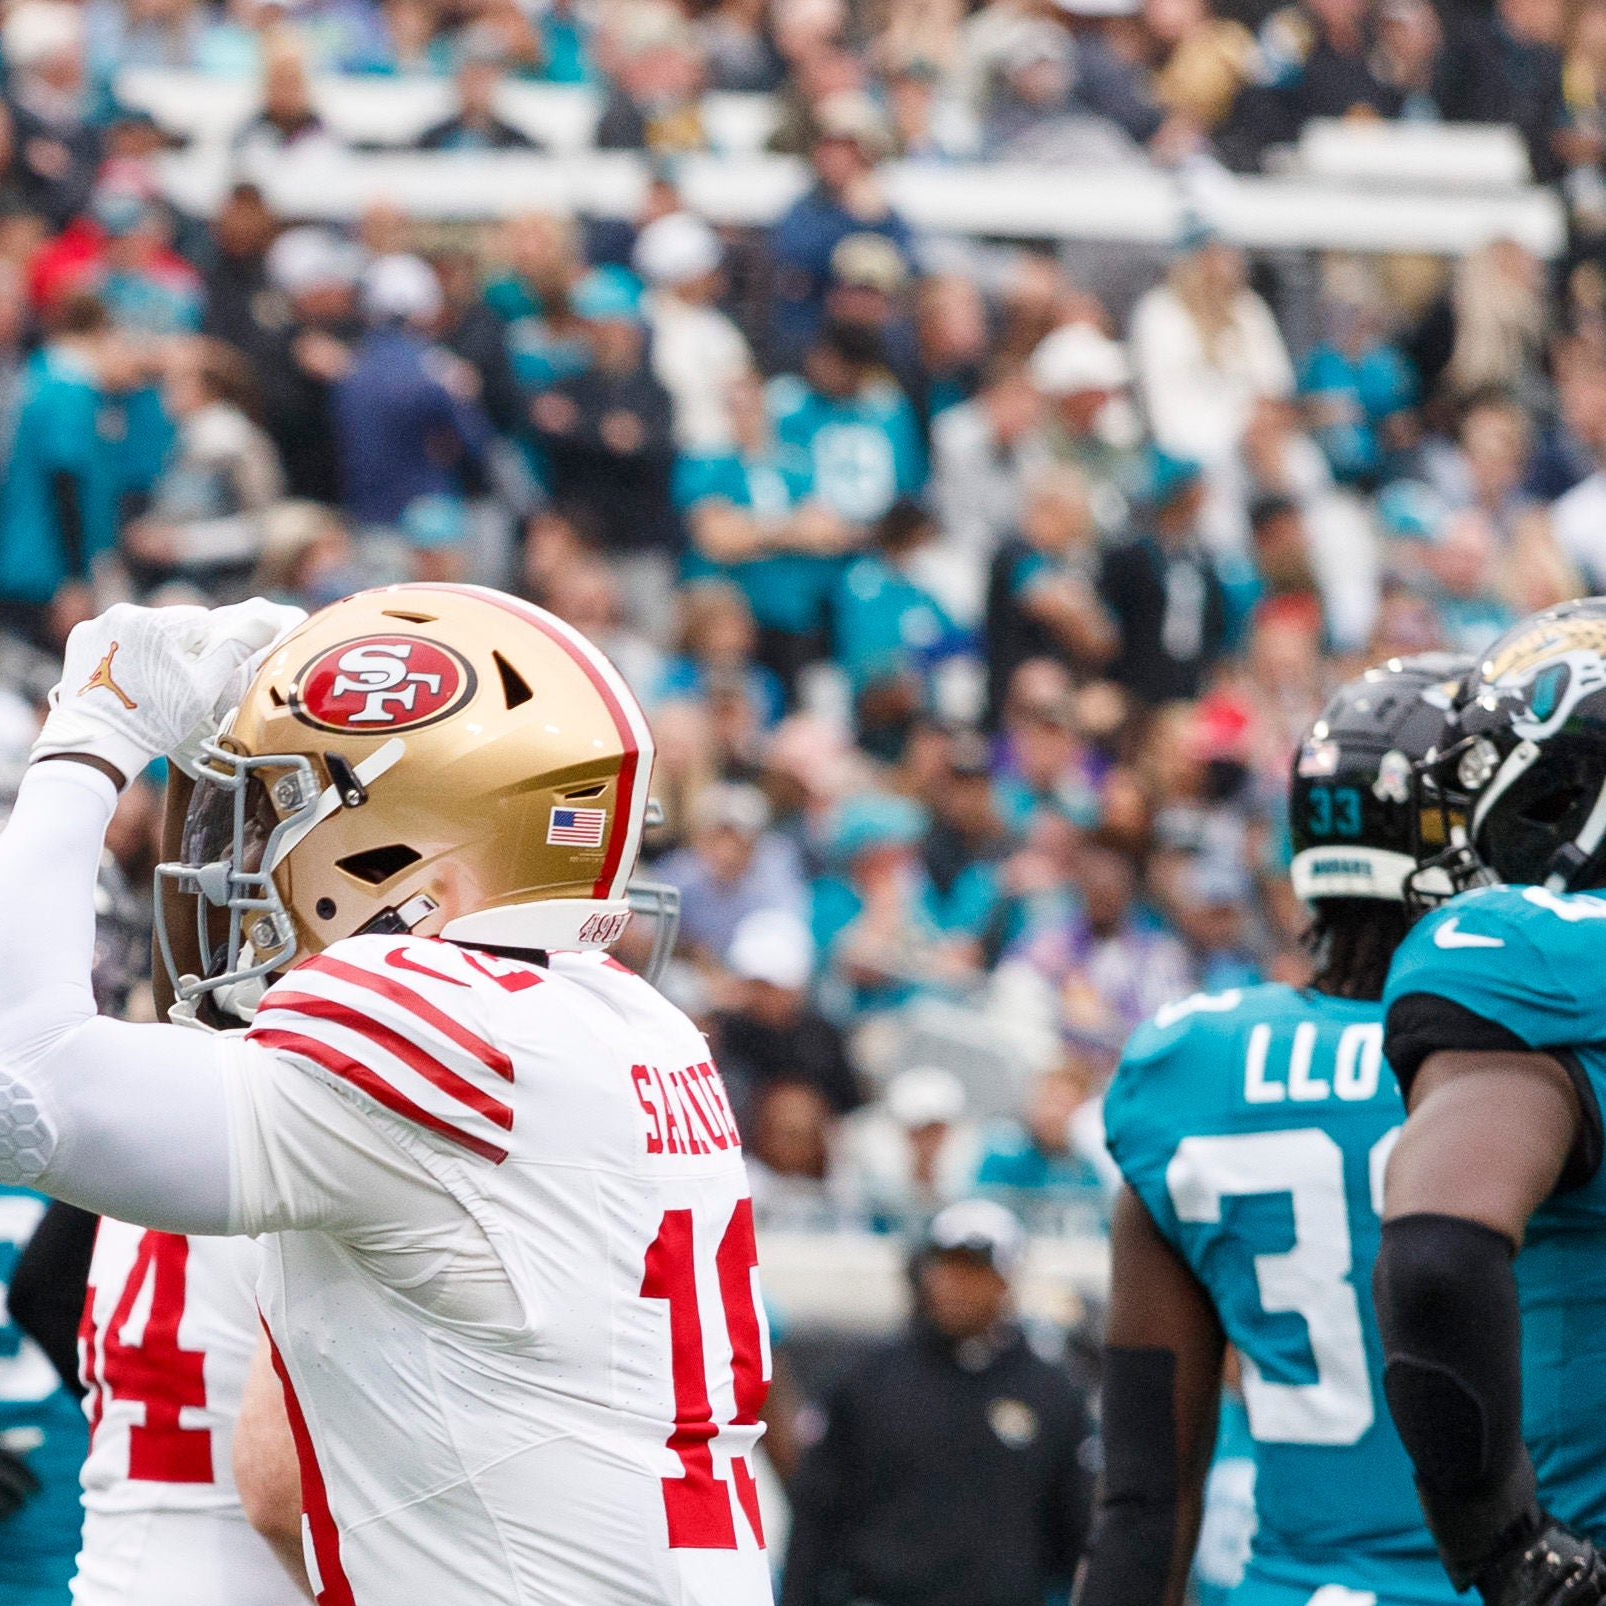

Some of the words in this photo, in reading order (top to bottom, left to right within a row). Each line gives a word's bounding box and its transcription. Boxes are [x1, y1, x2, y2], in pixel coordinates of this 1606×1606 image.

[332, 644, 441, 722] SF
[1308, 786, 1363, 837] 33
[1244, 1022, 1401, 1102] LLO
